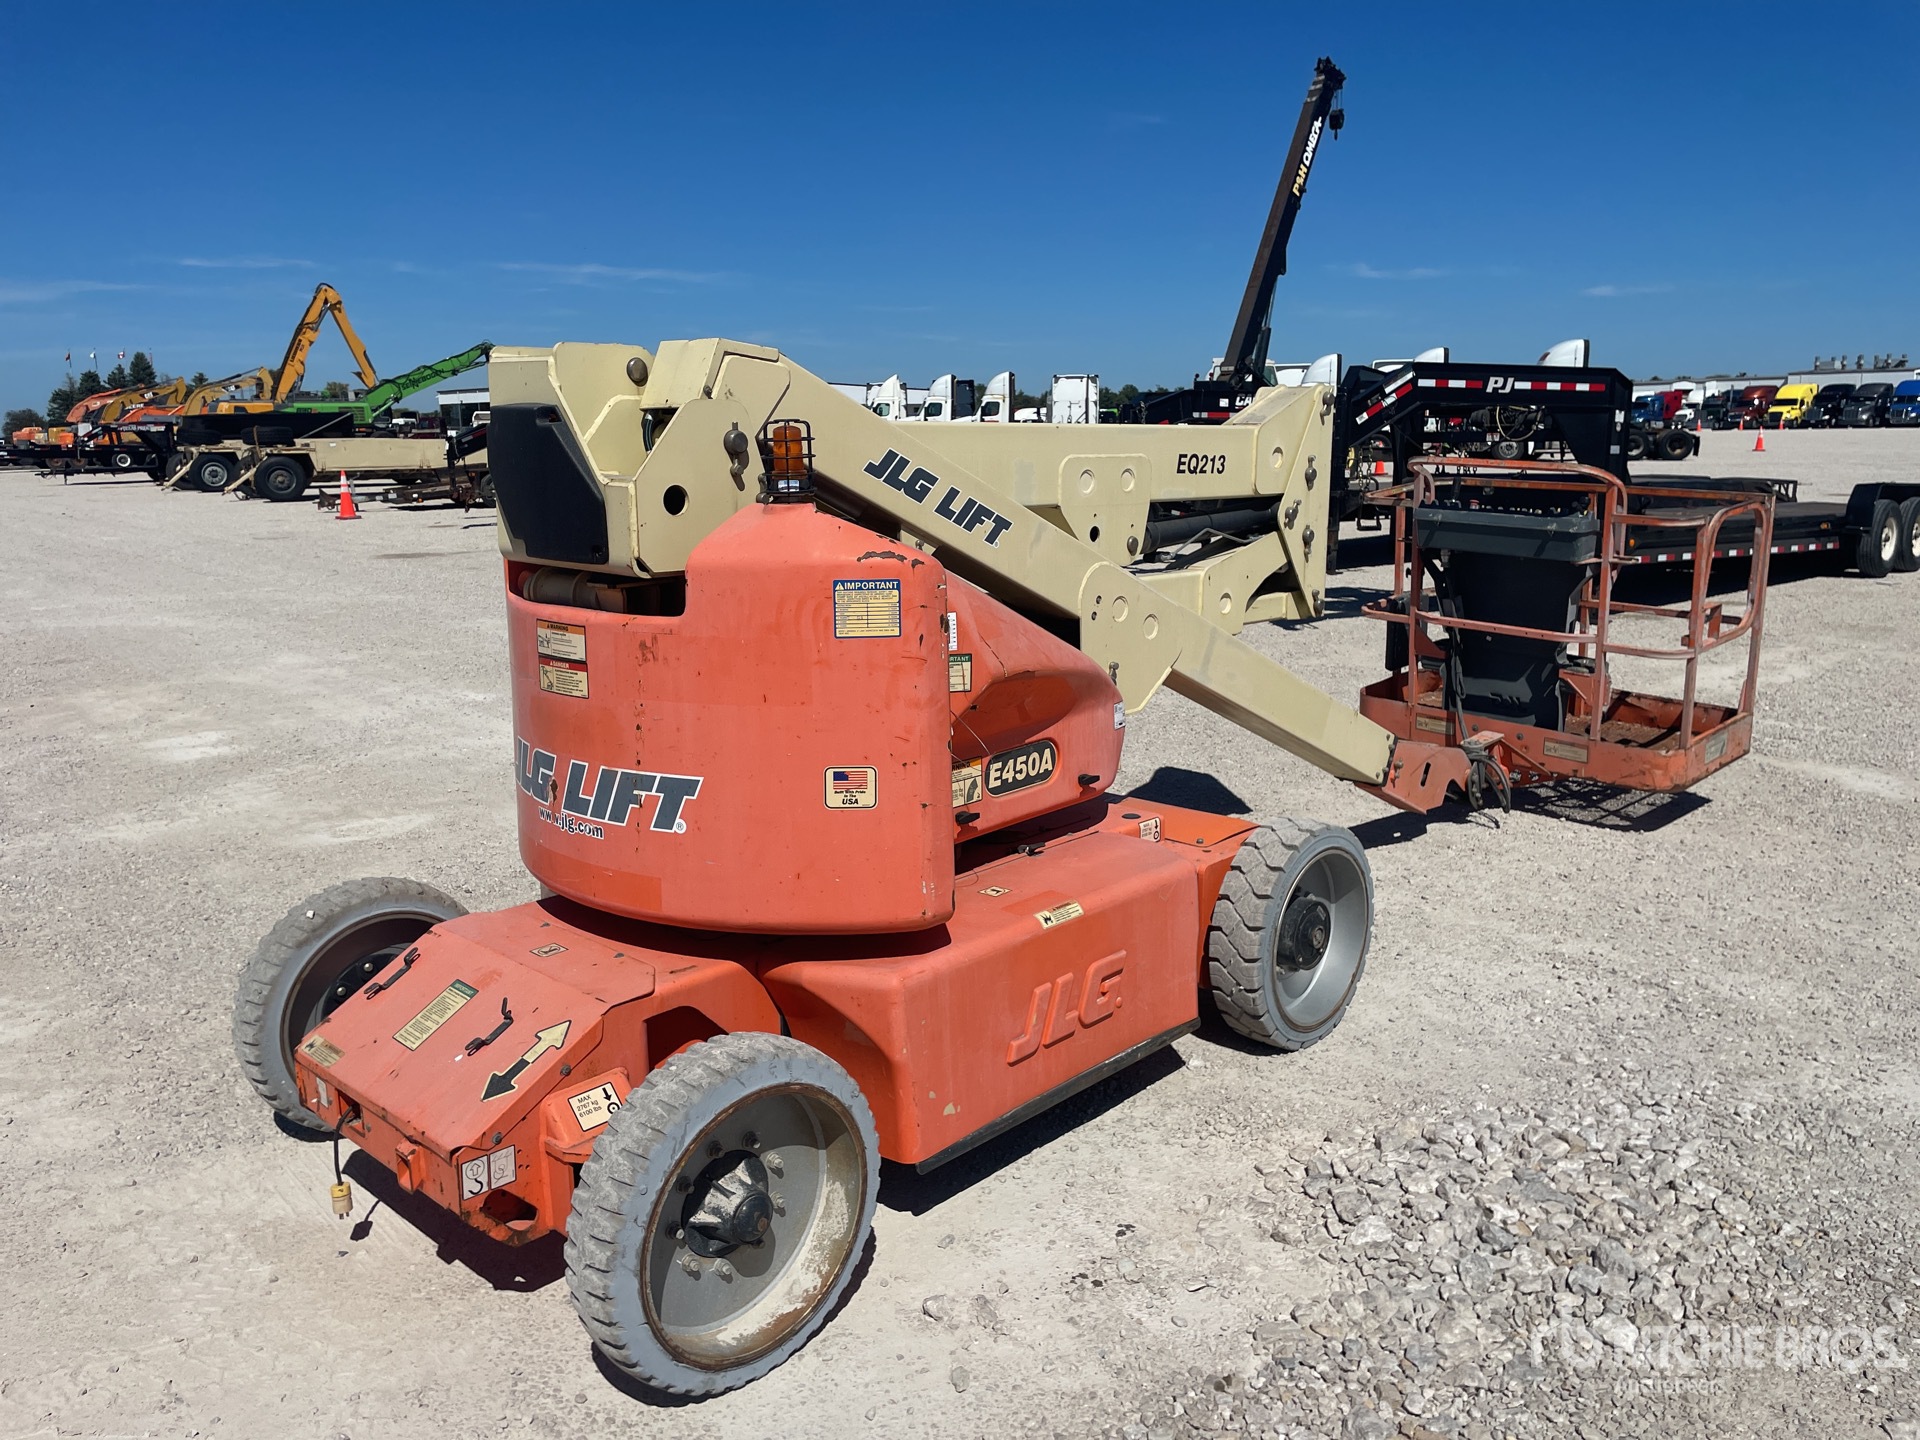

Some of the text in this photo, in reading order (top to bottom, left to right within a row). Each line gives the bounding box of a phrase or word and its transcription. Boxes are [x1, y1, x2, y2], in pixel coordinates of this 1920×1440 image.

[1292, 116, 1322, 197] P&H OMEGA
[1486, 376, 1515, 394] PJ
[1176, 453, 1226, 475] EQ213
[862, 447, 940, 505] JLG
[844, 582, 899, 590] IMPORTANT
[553, 661, 569, 669] DANGER
[988, 748, 1053, 790] E450A
[578, 1095, 591, 1103] MAX
[577, 1103, 590, 1111] 2767
[579, 1109, 593, 1117] 6100
